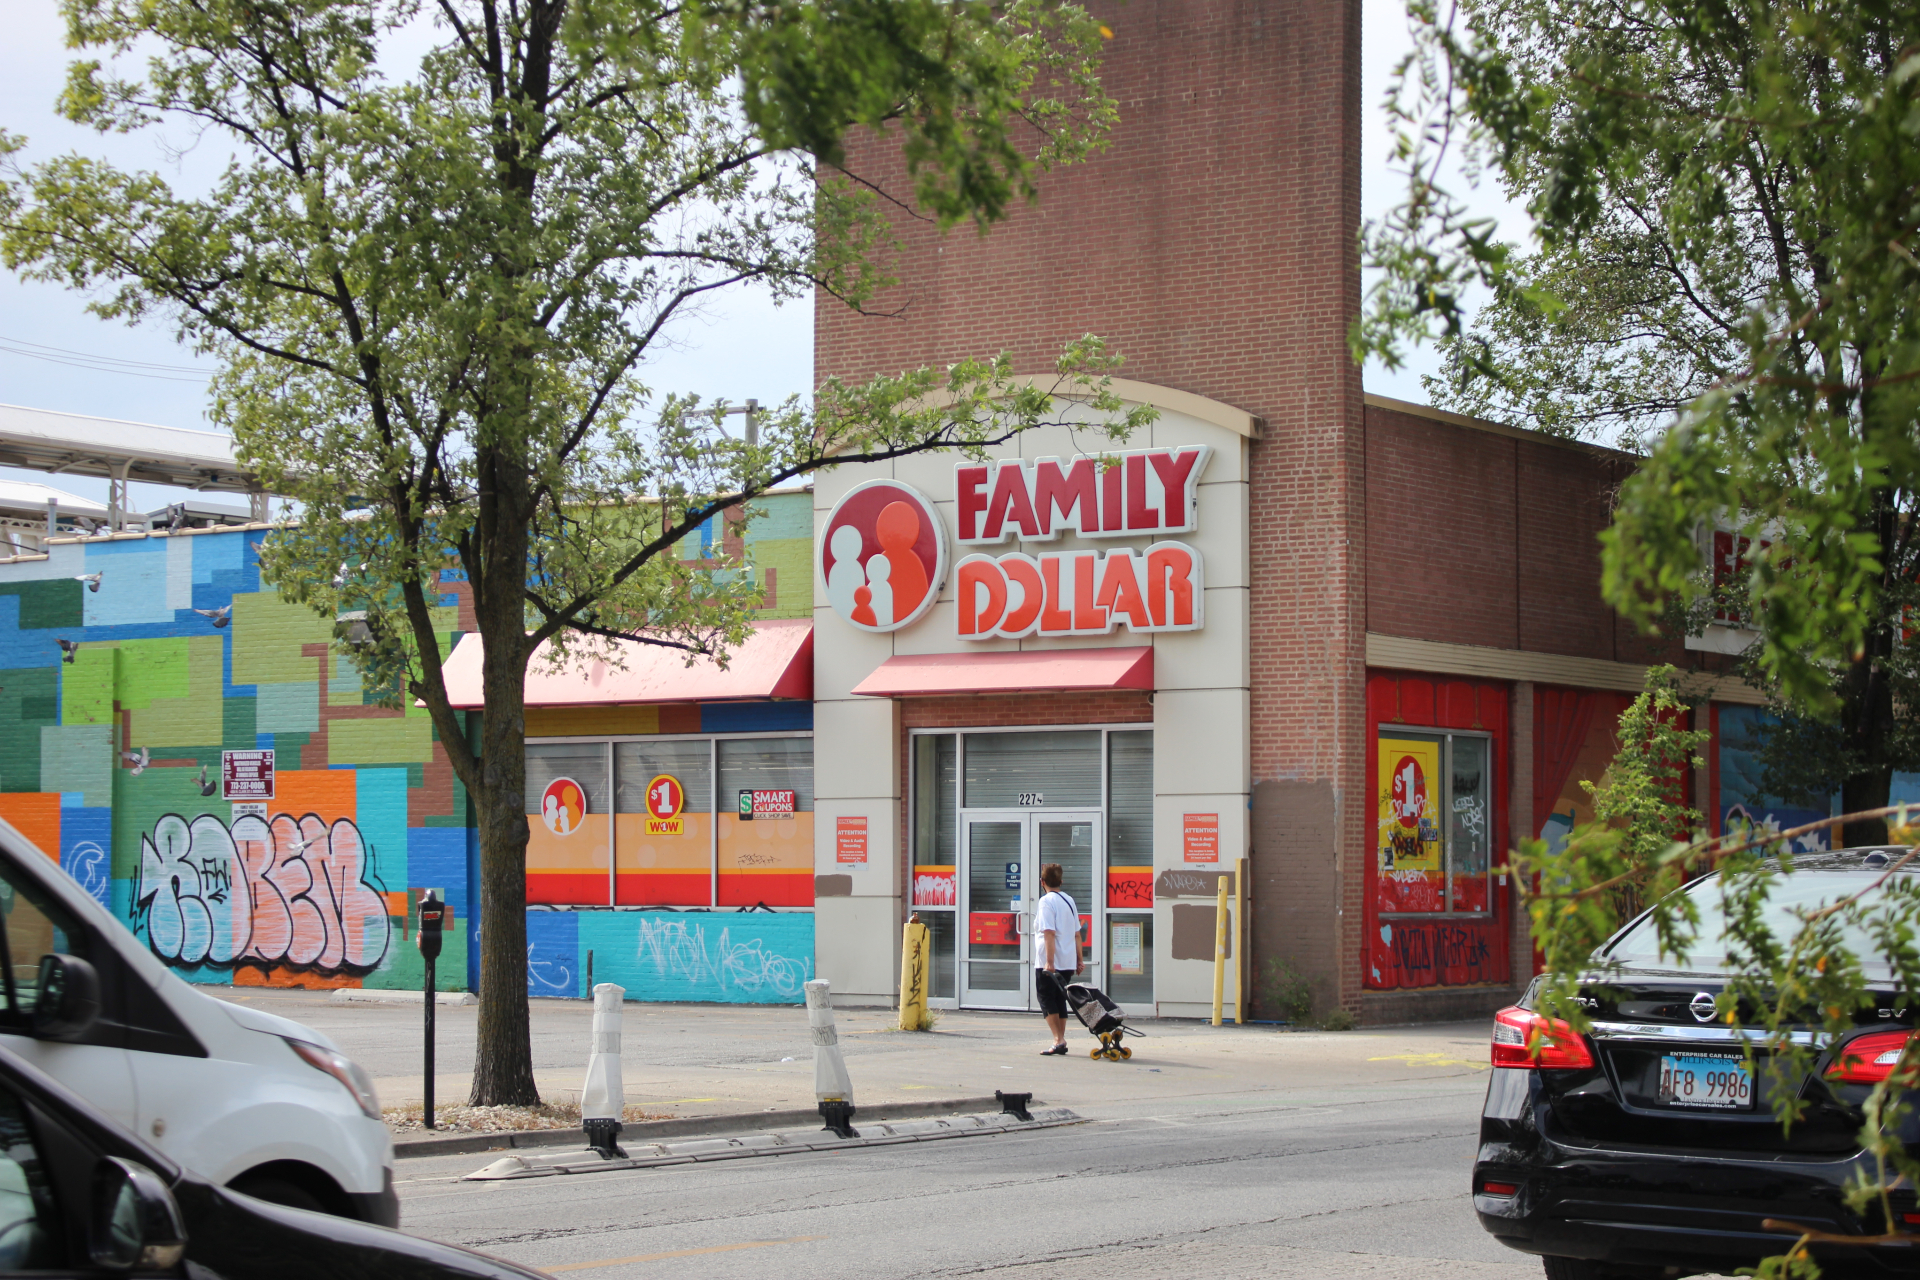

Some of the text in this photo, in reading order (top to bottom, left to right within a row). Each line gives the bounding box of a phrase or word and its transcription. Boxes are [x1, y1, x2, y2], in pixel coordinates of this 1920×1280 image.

[958, 450, 1200, 540] FAMILY
[958, 547, 1193, 636] DOLLAR
[232, 752, 263, 760] WARNING
[651, 782, 673, 813] $1
[753, 791, 793, 803] SMART
[1395, 763, 1418, 817] $1
[1878, 1008, 1907, 1018] SV
[1660, 1068, 1749, 1098] AF8 9986
